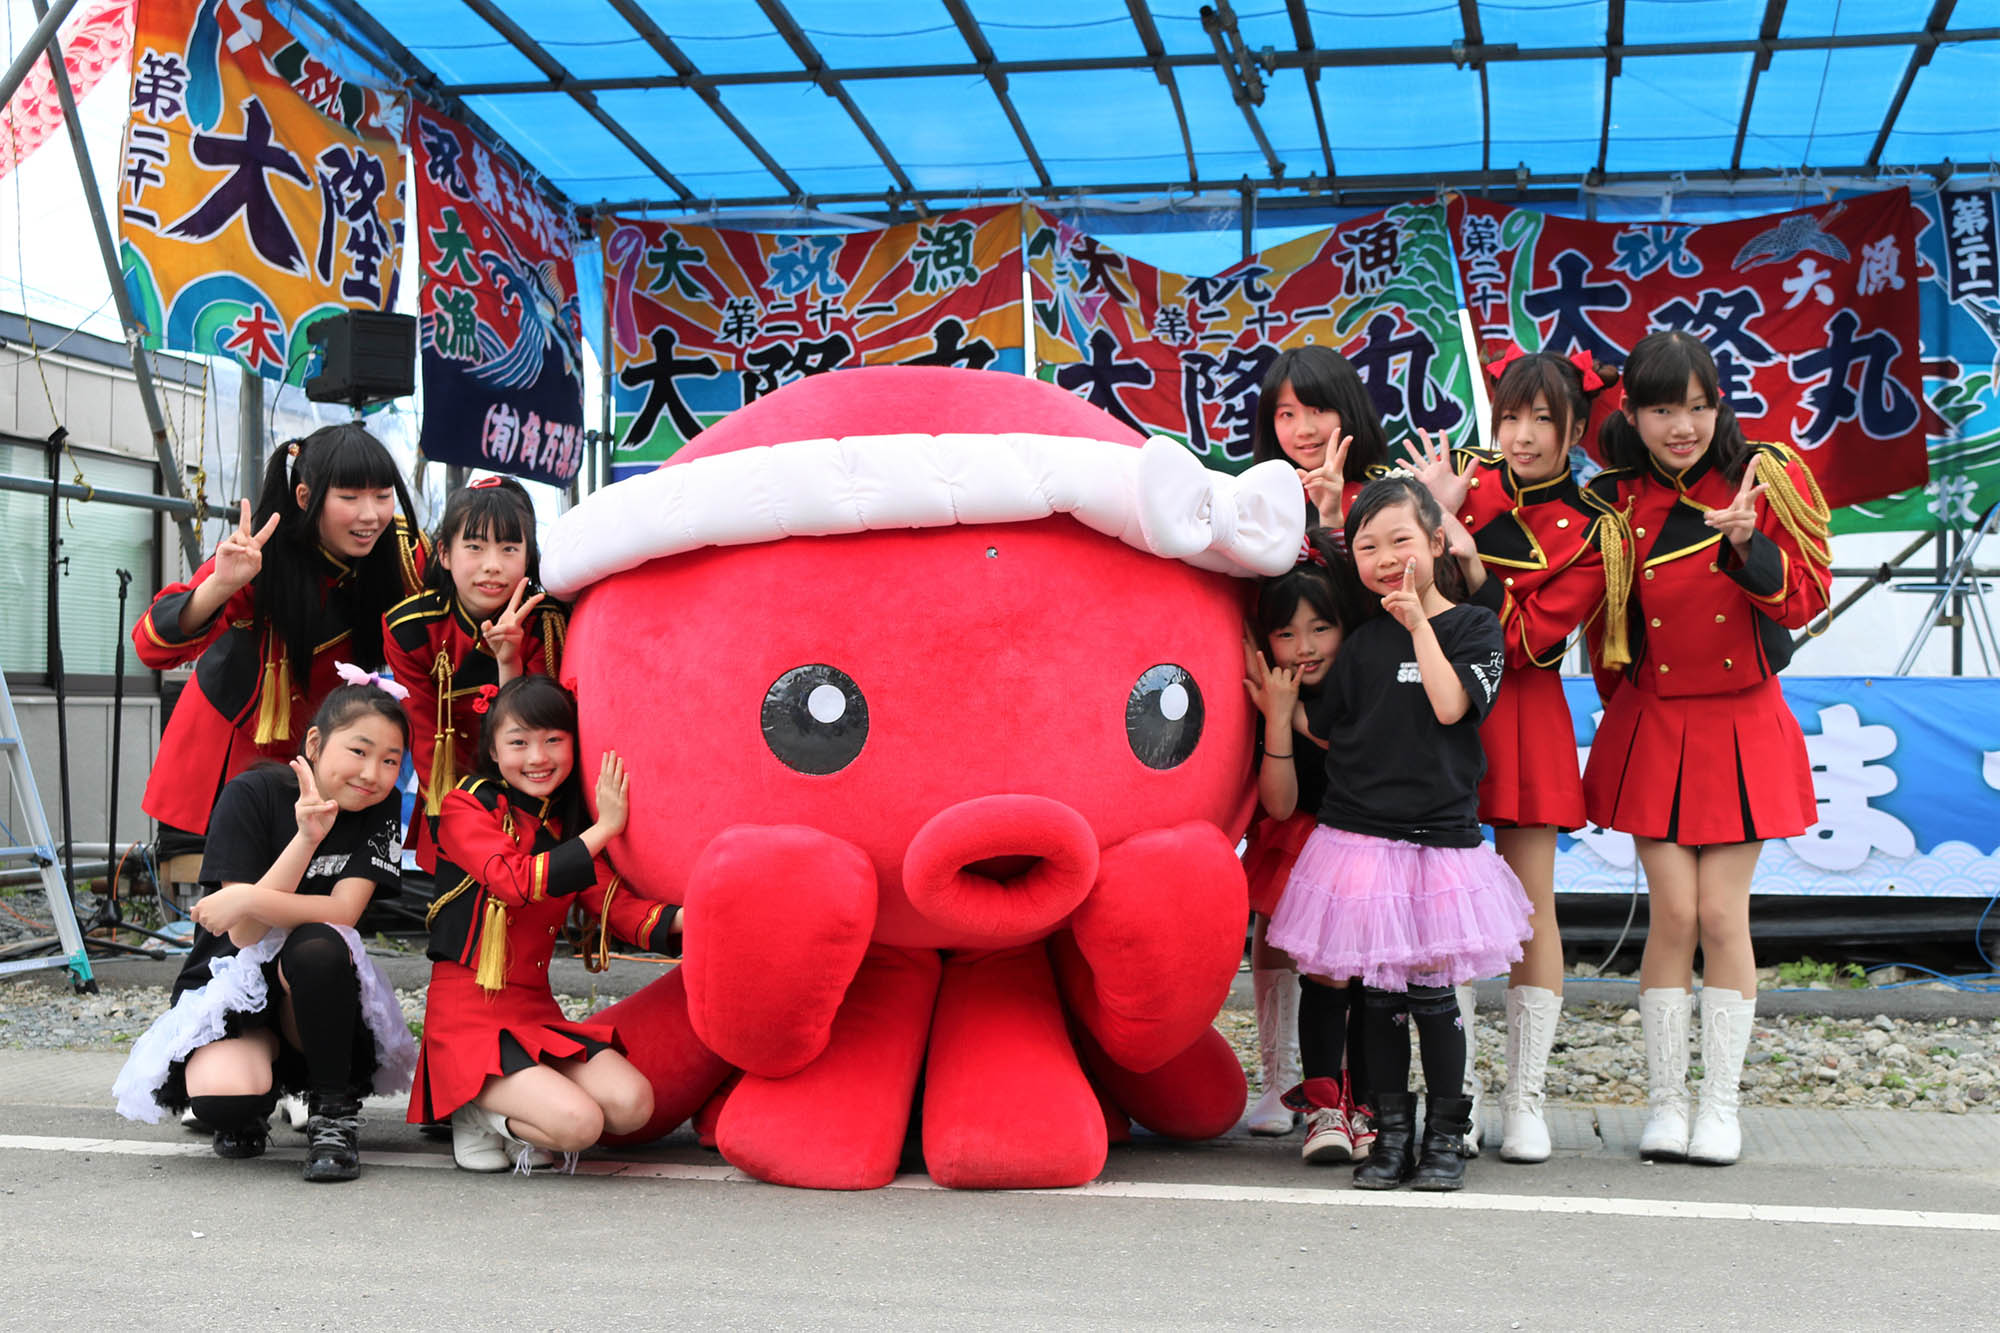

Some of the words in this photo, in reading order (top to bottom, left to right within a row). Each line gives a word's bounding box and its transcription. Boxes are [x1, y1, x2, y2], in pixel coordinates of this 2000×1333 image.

[123, 47, 192, 230] 第二十一
[427, 206, 482, 364] 大漁
[1461, 213, 1512, 342] 第二十一
[1606, 222, 1703, 281] 祝
[1951, 195, 1994, 292] 第二十一
[714, 297, 897, 345] 第二十一
[1151, 306, 1332, 345] 第二十一
